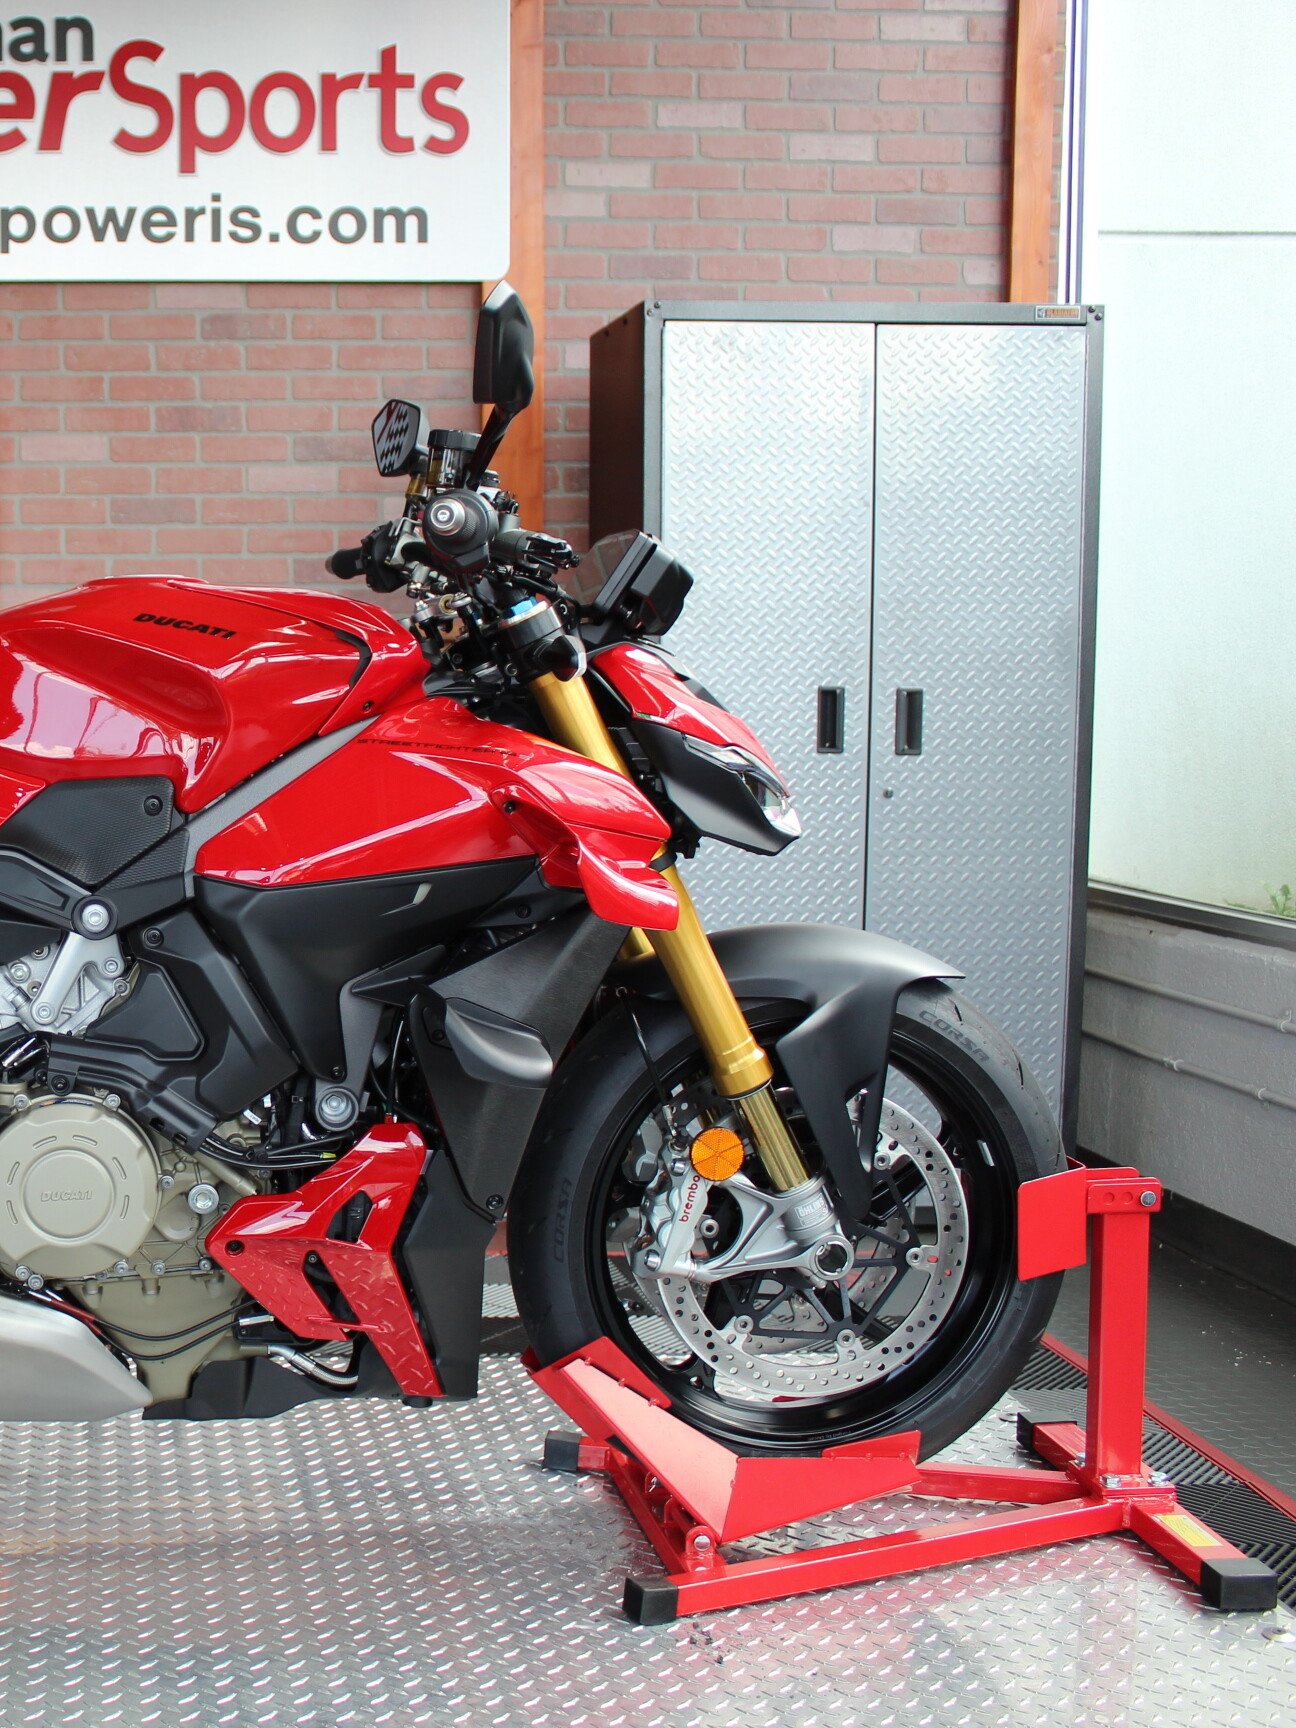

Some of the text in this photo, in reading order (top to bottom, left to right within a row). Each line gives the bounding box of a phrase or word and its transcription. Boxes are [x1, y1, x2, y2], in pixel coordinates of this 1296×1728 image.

[133, 613, 237, 639] DUCATI
[919, 1010, 990, 1062] CORSA
[40, 1190, 92, 1202] DUCATI
[679, 1174, 701, 1222] brembo
